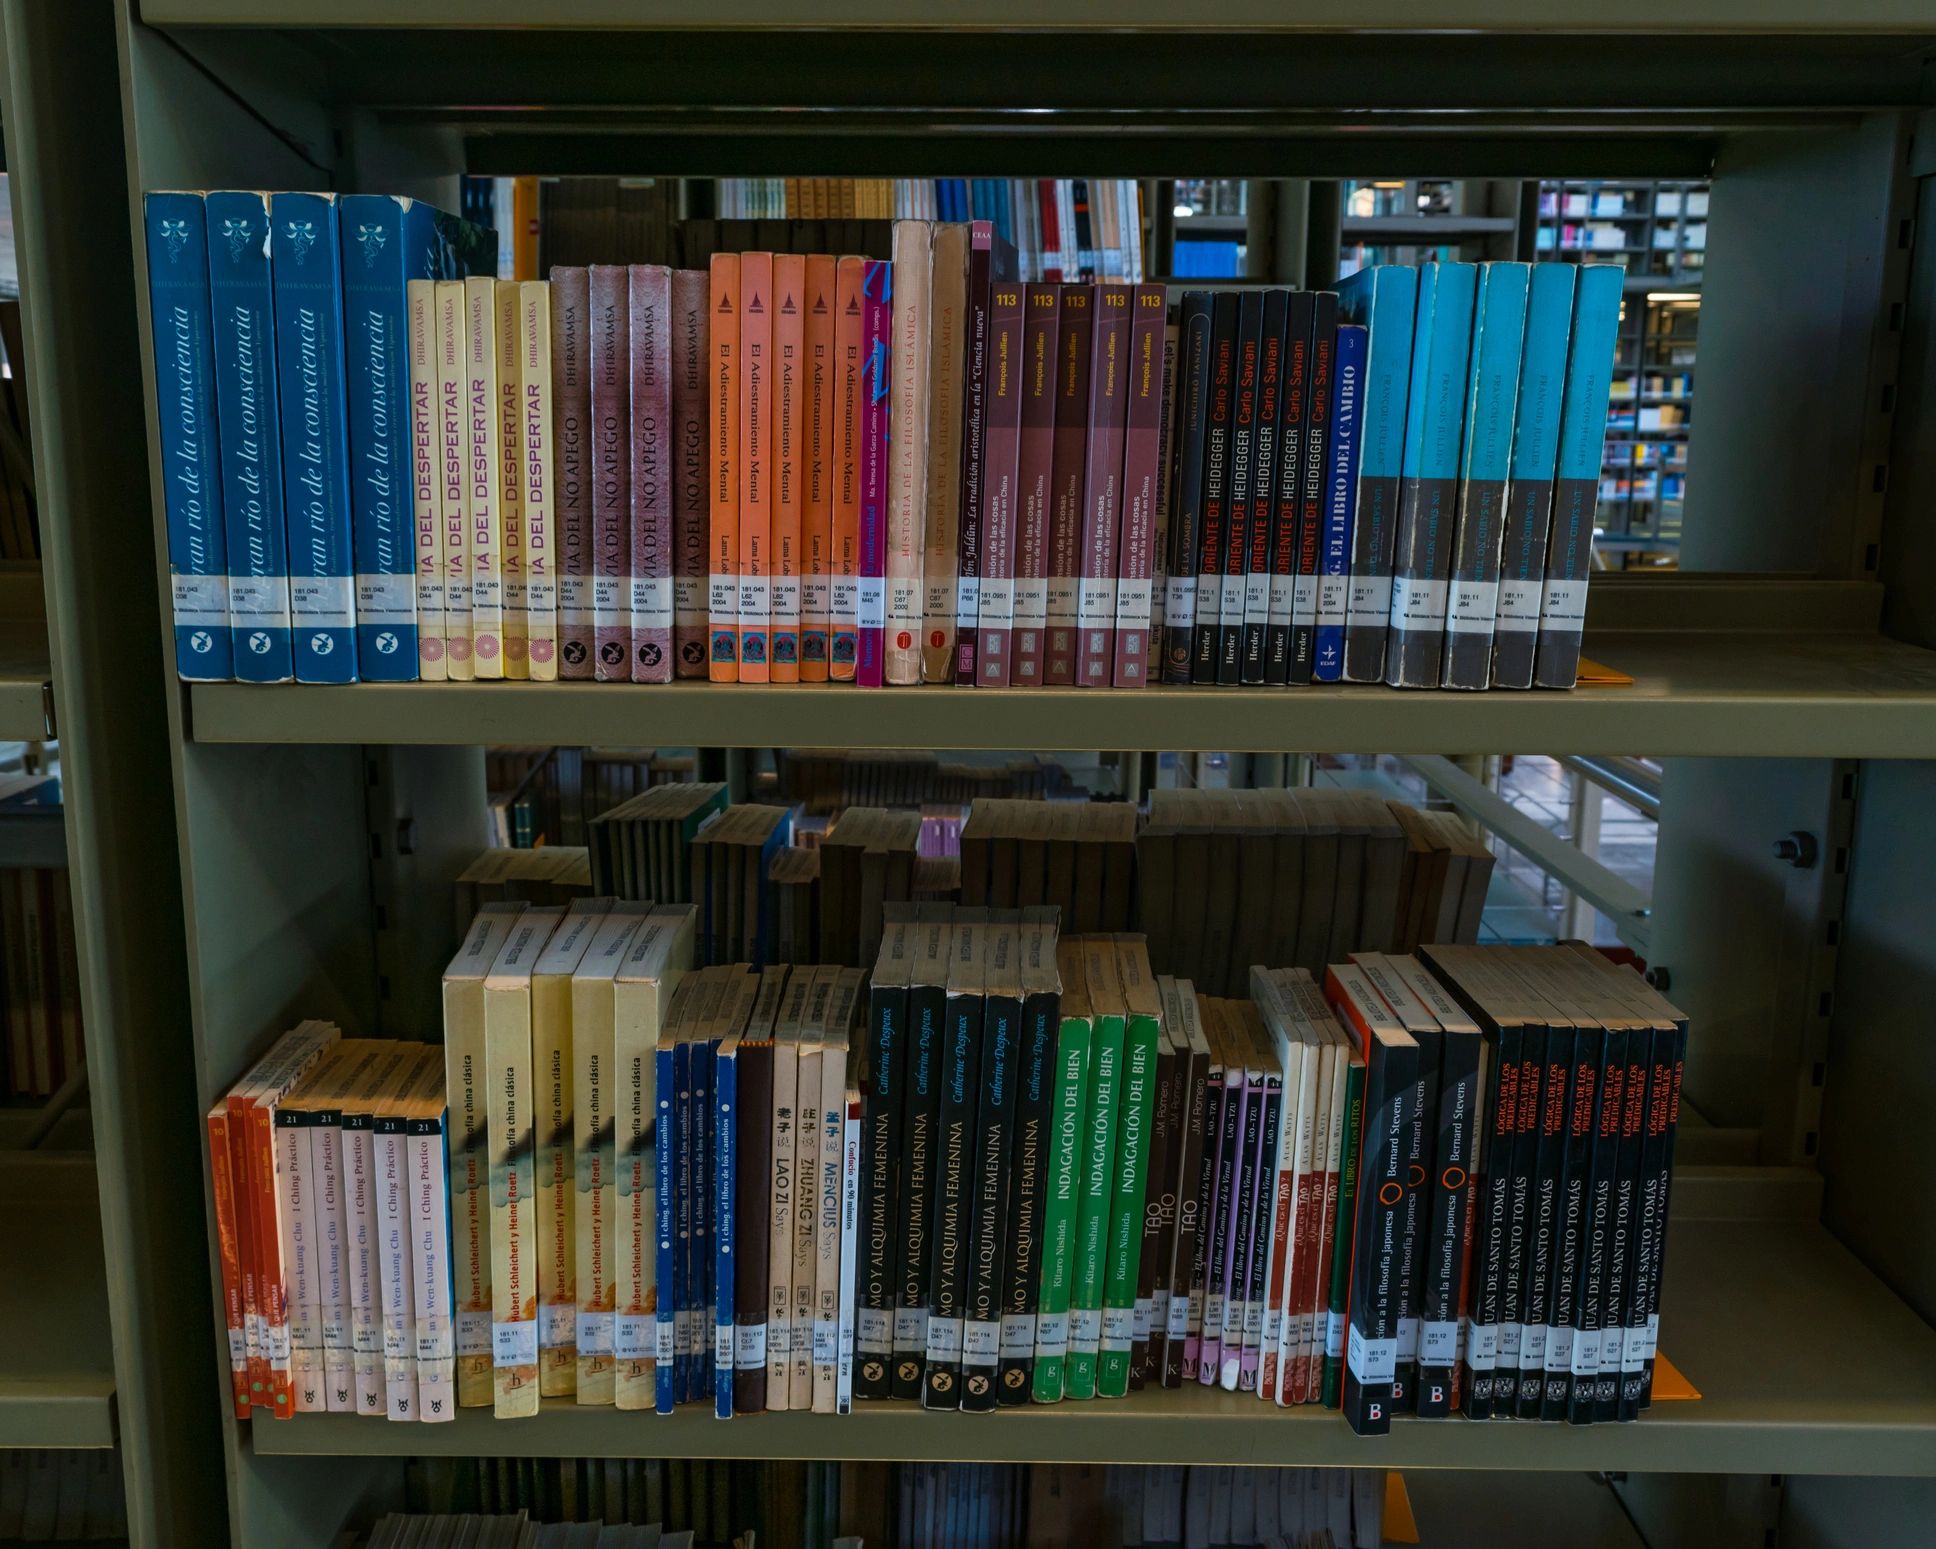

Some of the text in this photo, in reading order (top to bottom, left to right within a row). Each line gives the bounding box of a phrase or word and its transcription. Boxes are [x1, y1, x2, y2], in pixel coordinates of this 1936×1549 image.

[997, 294, 1015, 306] 113
[1141, 296, 1160, 306] 113
[415, 298, 425, 365] DHIRAVAMSA
[473, 296, 482, 362] DHIRAVAMSA
[528, 301, 537, 367] DHIRAVAMSA
[644, 305, 653, 385] DHIRAVAMSA
[1348, 338, 1353, 348] 3
[168, 305, 195, 435] consciencia
[293, 307, 319, 438] consciencia
[998, 331, 1007, 395] François Jullien
[1141, 332, 1151, 396] François Jullien
[971, 382, 981, 391] la
[973, 395, 980, 405] en
[719, 344, 729, 502] El Adiestramiento Mental
[842, 346, 855, 504] El Adiestramiento Mental
[901, 304, 915, 556] HISTORIA DE LA FILOSOFÍA ISLÁMICA
[968, 408, 980, 458] aristotélica
[175, 439, 196, 462] la
[298, 440, 320, 464] la
[416, 382, 432, 545] DEL DESPERTAR
[472, 379, 489, 543] DEL DESPERTAR
[527, 384, 543, 548] DEL DESPERTAR
[869, 459, 876, 467] de
[1204, 338, 1229, 572] ORIENTE DE HEIDEGGER Carlo Saviani
[1330, 365, 1355, 556] EL LIBRO DEL CAMBIO
[177, 465, 199, 494] de
[299, 467, 322, 496] de
[643, 417, 656, 547] DEL NO APEGO
[868, 468, 876, 485] Teresa
[966, 460, 978, 502] tradición
[1000, 475, 1008, 497] China
[180, 498, 201, 531] río
[302, 501, 324, 533] río
[966, 505, 976, 518] La
[1001, 499, 1007, 508] en
[989, 524, 998, 538] las
[998, 510, 1007, 537] eficacia
[988, 540, 997, 552] de
[998, 548, 1005, 557] de
[964, 560, 975, 576] Ibn
[1200, 630, 1211, 660] Herder
[1298, 631, 1308, 661] Herder
[990, 1017, 1008, 1105] Catherine Despeux
[505, 1067, 514, 1097] clásica
[1495, 1062, 1510, 1134] LÓGICA DE LOS
[1504, 1066, 1519, 1129] PREDICABLES
[418, 1123, 428, 1132] 21
[506, 1100, 515, 1124] china
[1056, 1049, 1080, 1199] INDAGACIÓN DEL BIEN
[1449, 1081, 1465, 1160] Bernard Stevens
[1386, 1096, 1401, 1176] Bernard Stevens
[419, 1141, 429, 1179] Práctico
[661, 1164, 667, 1174] de
[775, 1158, 788, 1188] LAO
[847, 1141, 856, 1175] Confucio
[984, 1123, 1000, 1200] FEMENINA
[421, 1183, 432, 1212] Ching
[508, 1172, 516, 1196] Roetz
[661, 1197, 668, 1205] el
[775, 1192, 788, 1203] ZI
[847, 1189, 854, 1199] 90
[509, 1200, 517, 1229] Heiner
[794, 1158, 814, 1266] ZHUANG ZI Says
[820, 1162, 837, 1259] MENCIUS Says
[1181, 1199, 1197, 1235] TAO
[1616, 1179, 1631, 1226] TOMÁS
[980, 1205, 997, 1279] ALQUIMIA
[1381, 1210, 1395, 1253] japonesa
[509, 1240, 519, 1288] Schleichert
[1052, 1218, 1066, 1287] Kitaro Nishida
[1612, 1229, 1626, 1273] SANTO
[423, 1231, 436, 1308] Wen-kuang Chu
[1378, 1255, 1390, 1294] filosofía
[1611, 1277, 1621, 1293] DE
[510, 1292, 519, 1321] Hubert
[1377, 1298, 1387, 1306] la
